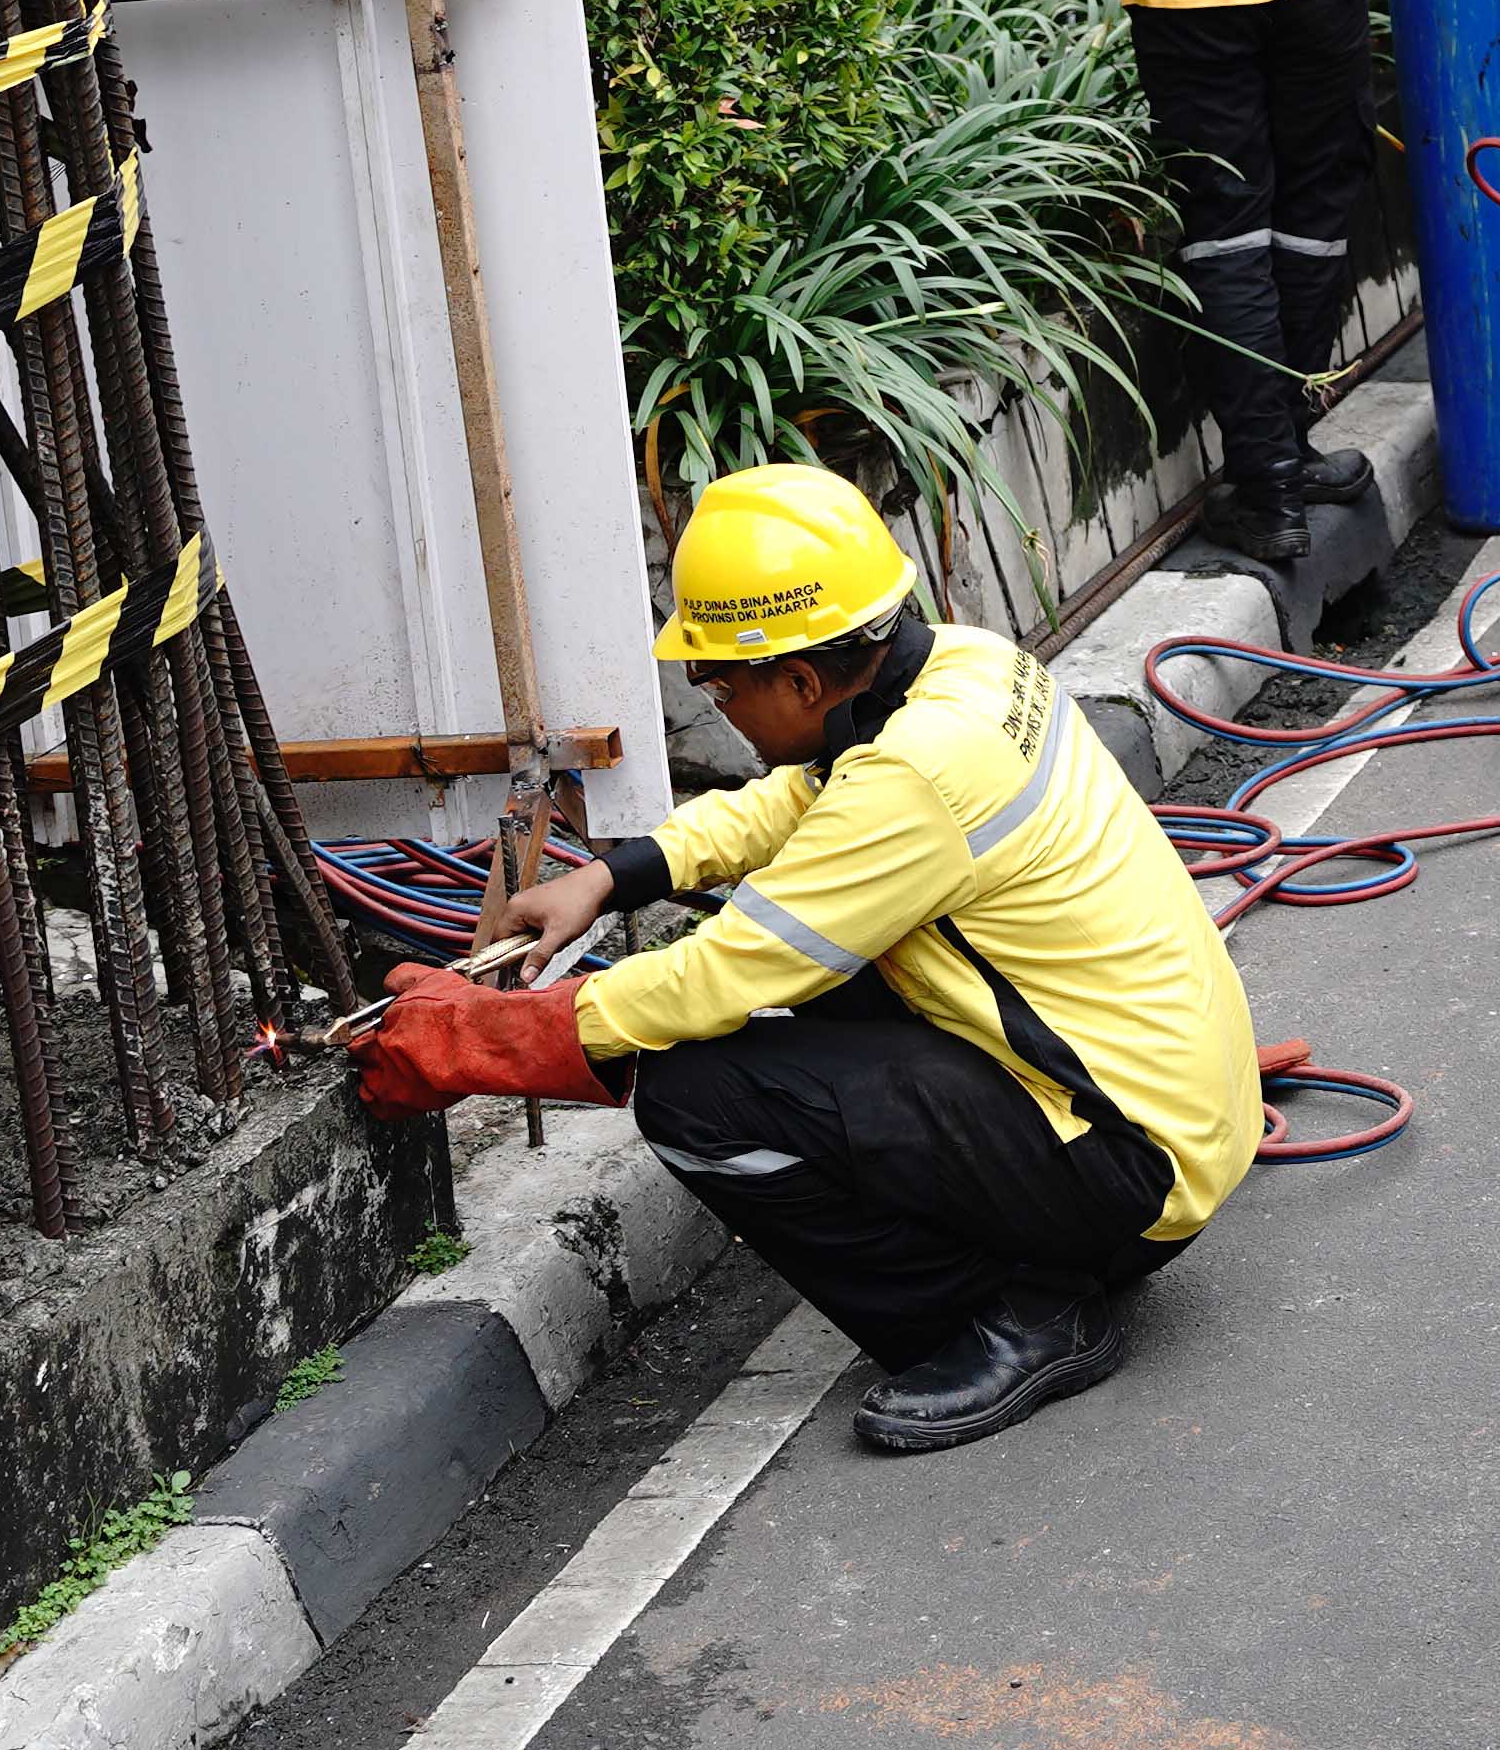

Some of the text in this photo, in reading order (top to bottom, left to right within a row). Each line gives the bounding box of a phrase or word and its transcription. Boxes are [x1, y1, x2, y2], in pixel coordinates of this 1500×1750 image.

[692, 597, 819, 624] PROVINSI DKI JAKARTA
[705, 599, 738, 612] DINAS
[740, 595, 771, 609] BINA
[773, 582, 824, 604] MARGA
